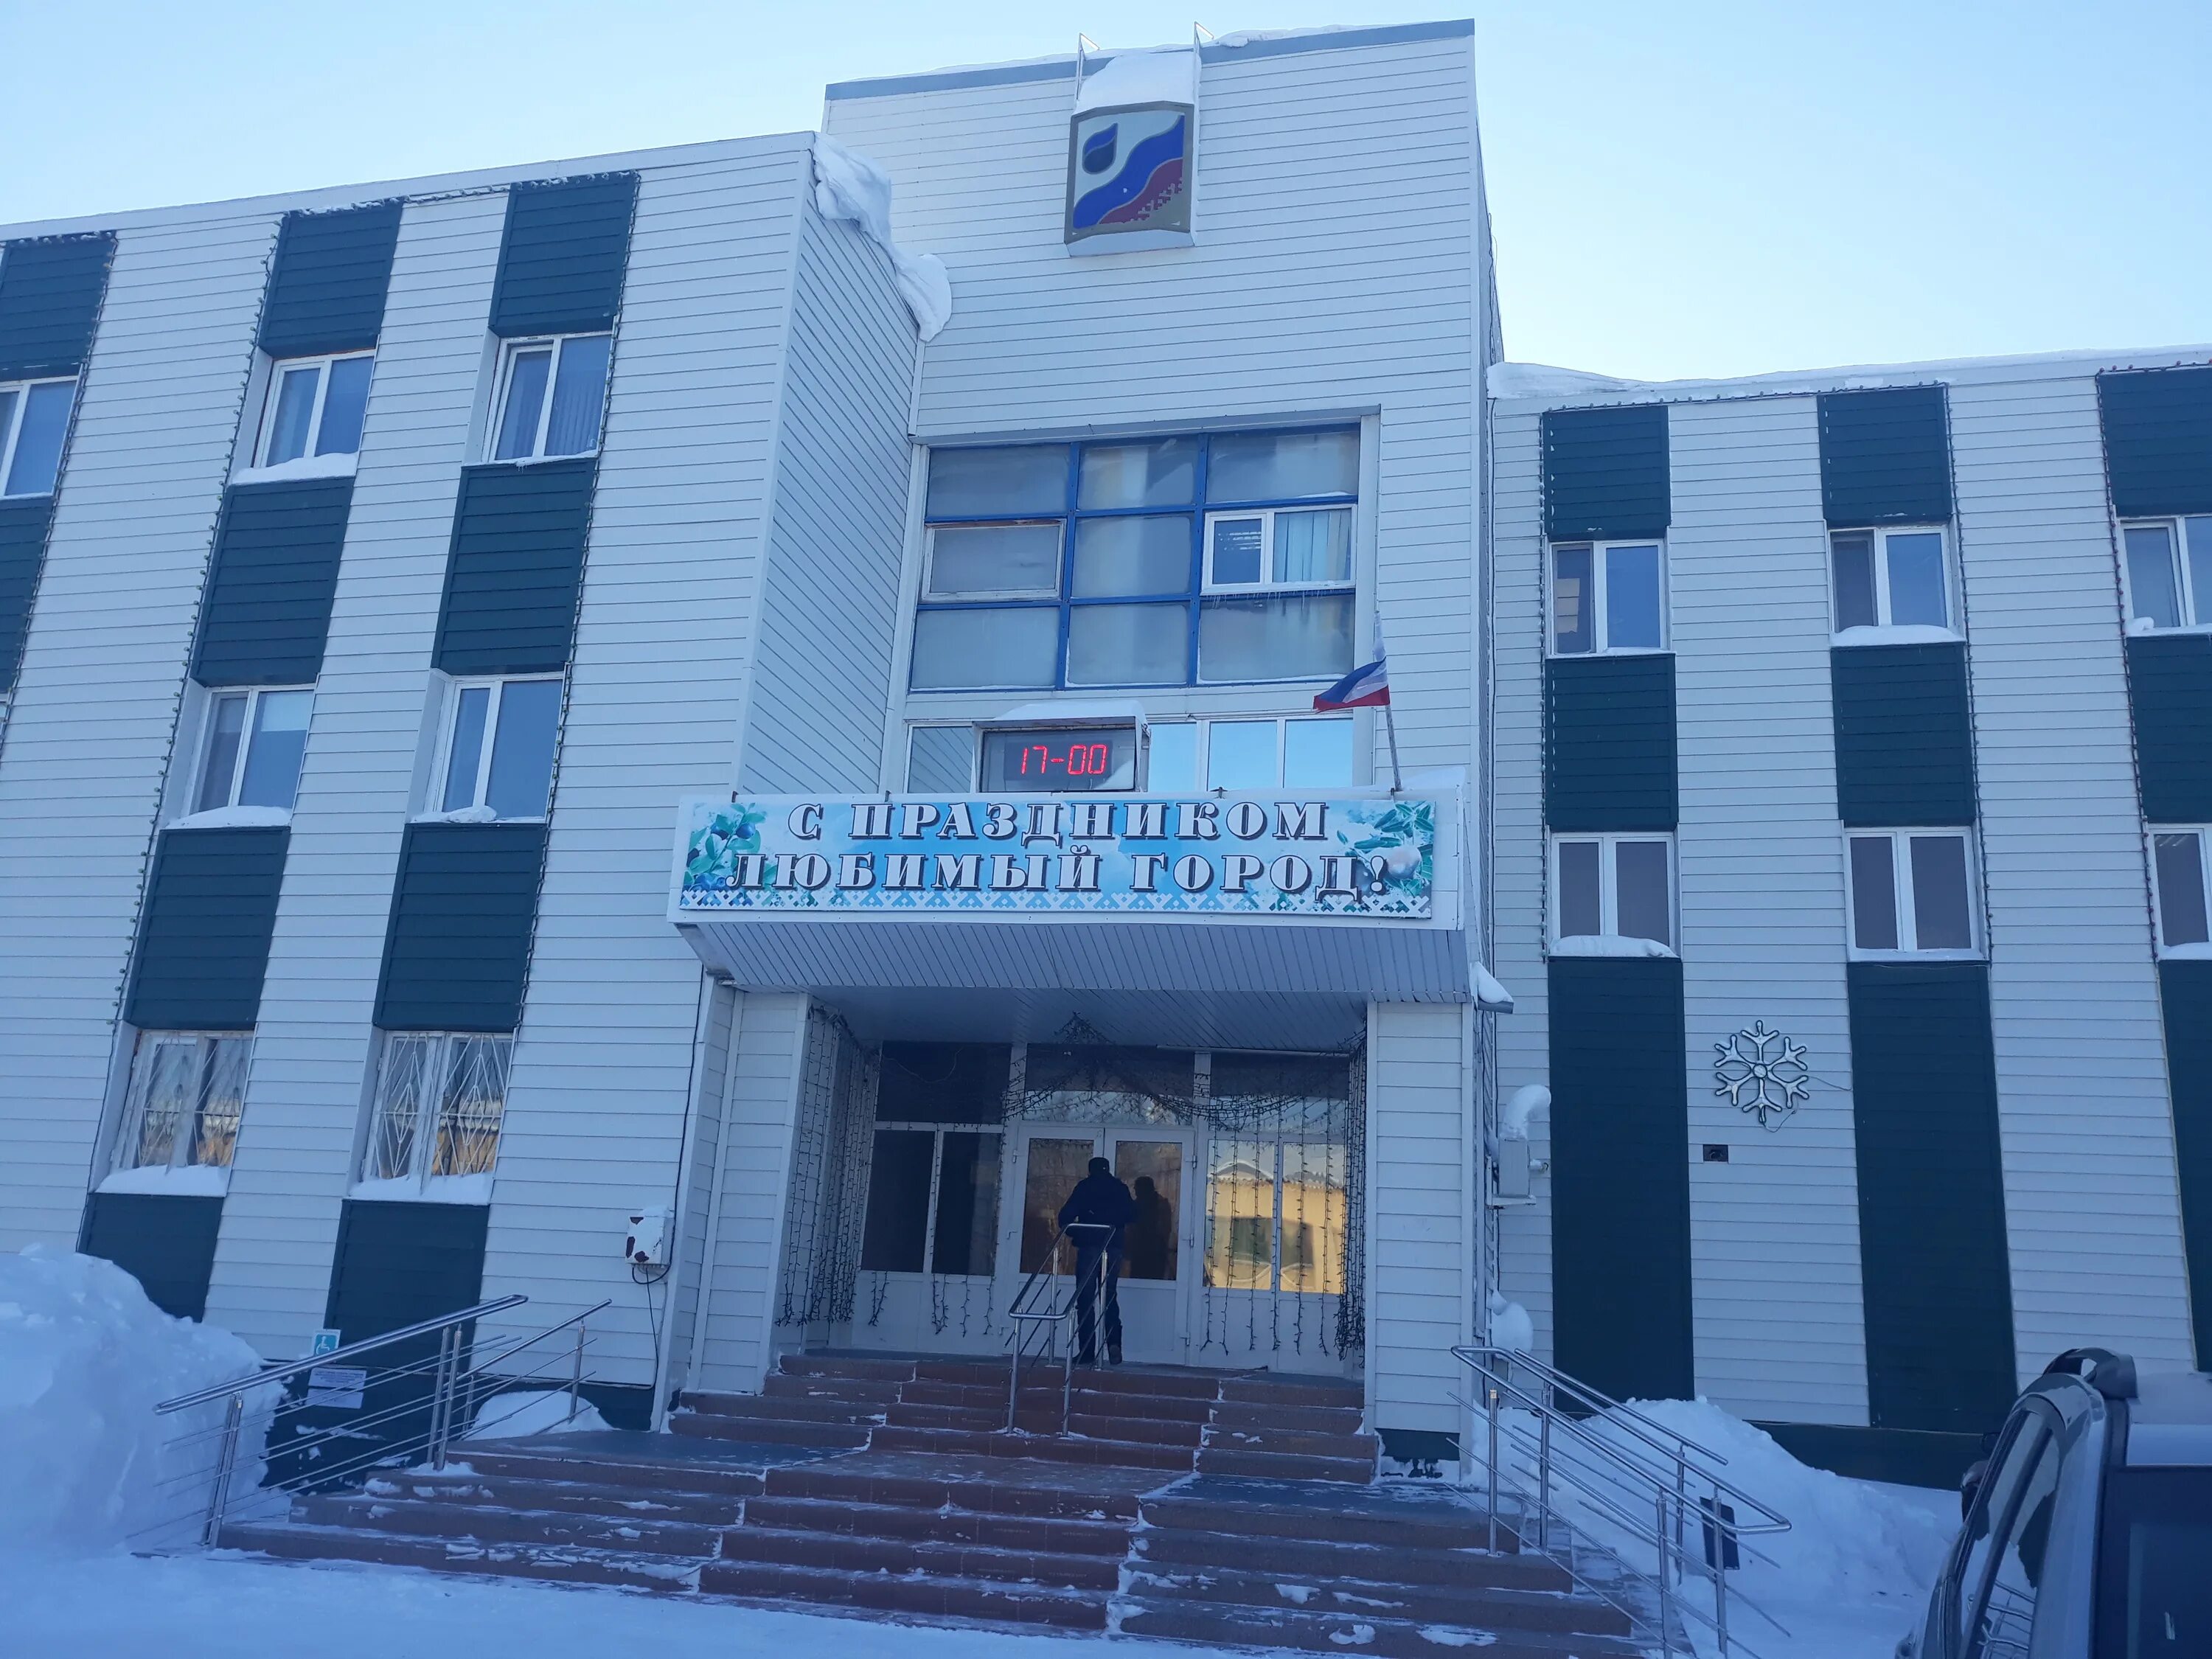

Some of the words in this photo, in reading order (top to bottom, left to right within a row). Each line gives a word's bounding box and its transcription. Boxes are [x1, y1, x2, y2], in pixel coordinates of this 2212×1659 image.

[1020, 744, 1107, 775] 17-00
[787, 803, 824, 840] С
[848, 801, 1329, 847] ПРАЗДНИКОМ
[725, 844, 1105, 891] ЛЮБИМЫЙ
[1130, 852, 1388, 902] ГОРОД!
